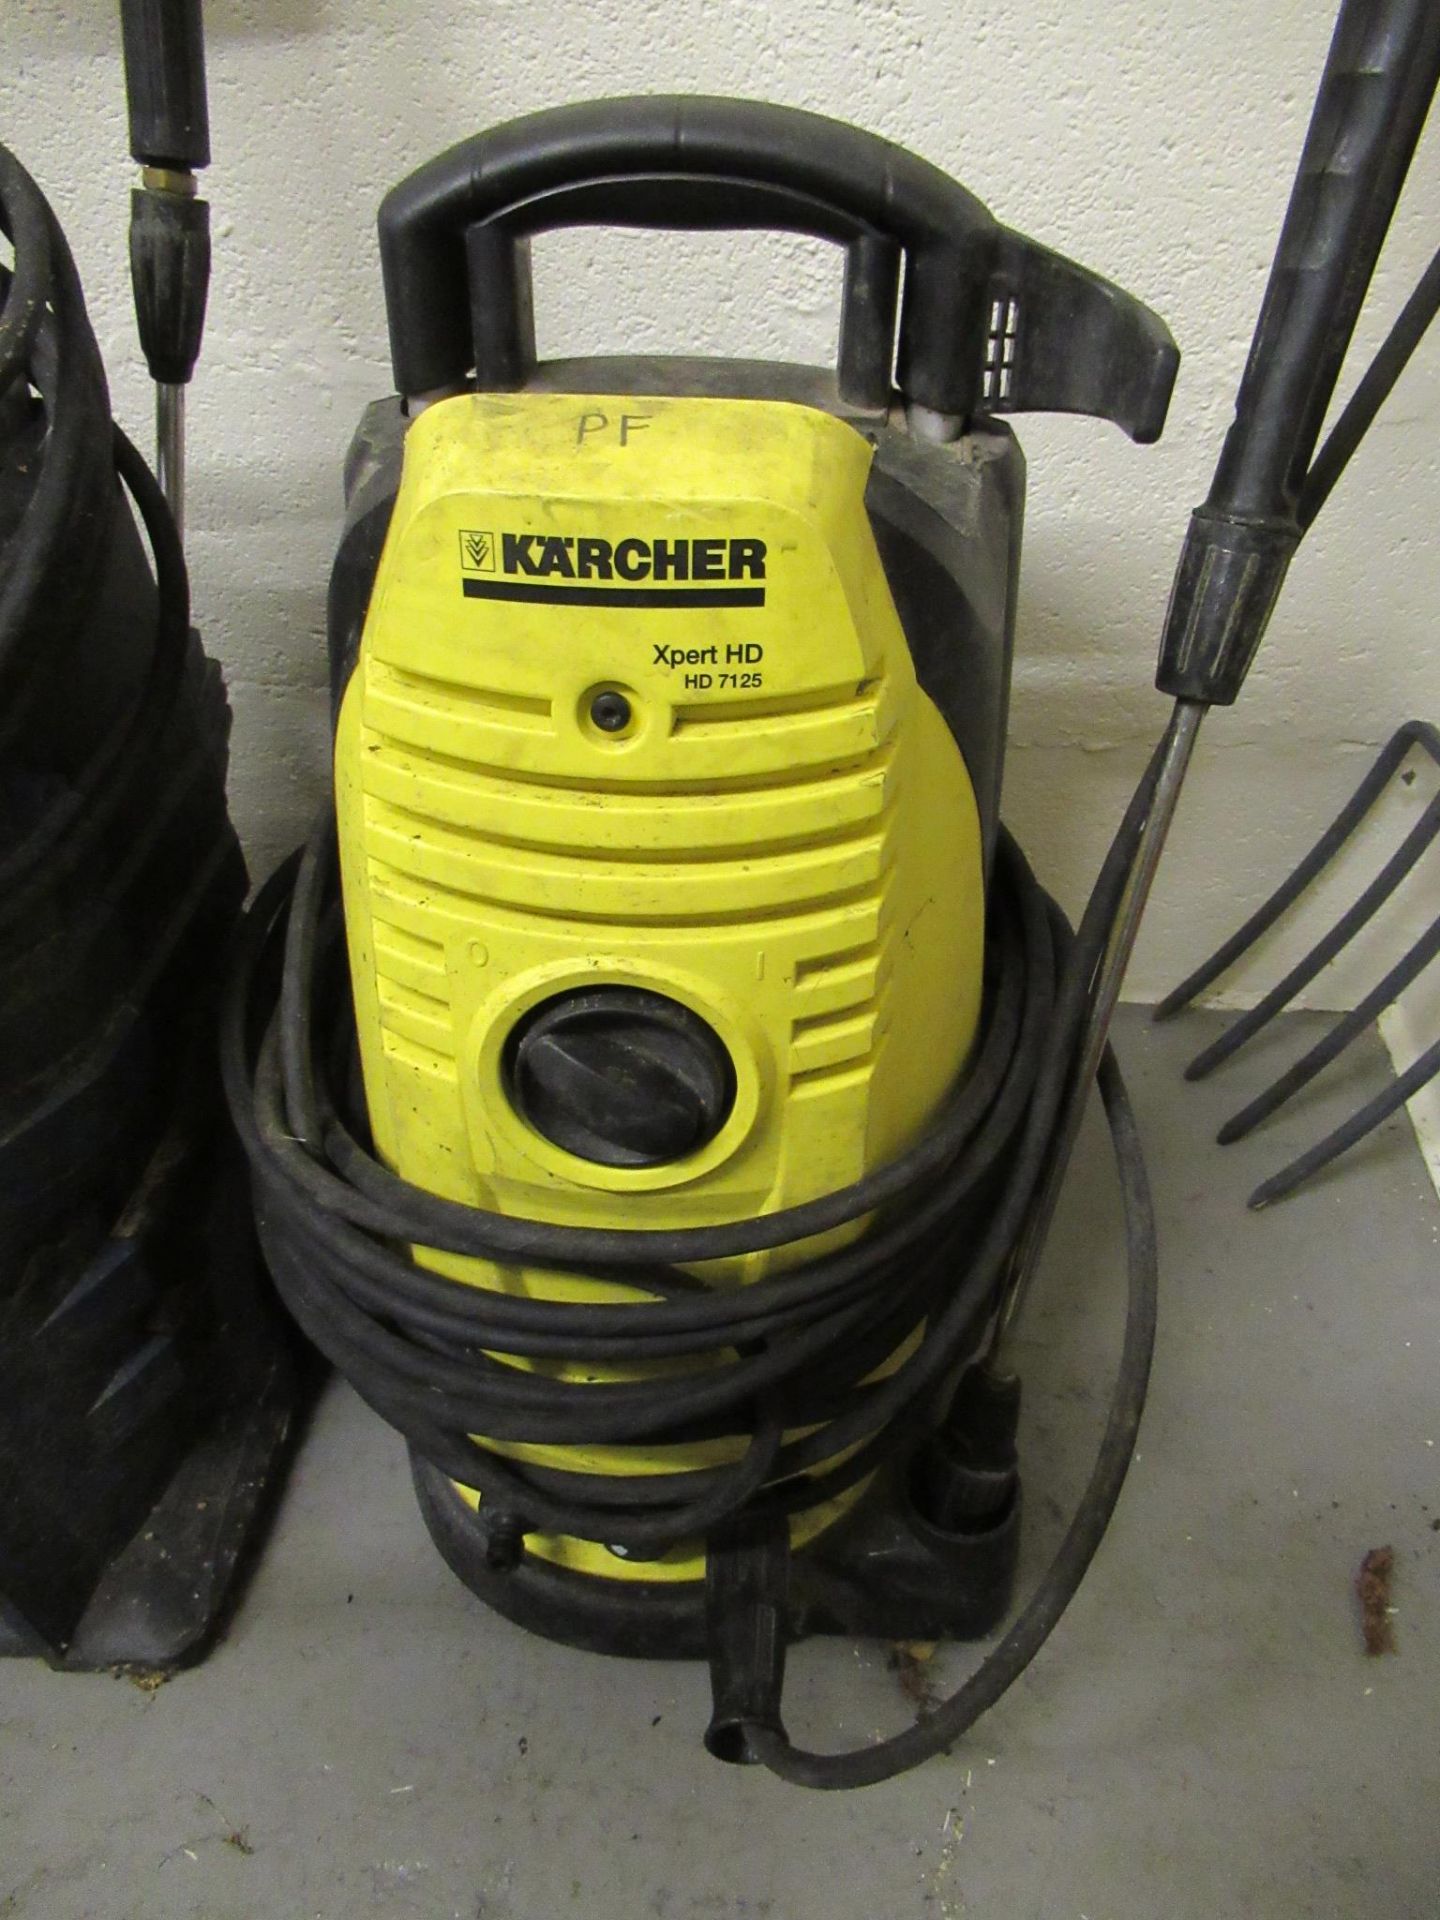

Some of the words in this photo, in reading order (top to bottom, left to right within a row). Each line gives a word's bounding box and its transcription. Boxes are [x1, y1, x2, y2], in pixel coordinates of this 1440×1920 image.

[501, 533, 767, 580] KÄRCHER
[653, 645, 717, 668] Xpert
[726, 643, 763, 664] HD
[684, 675, 713, 688] HD
[718, 673, 762, 688] 7125
